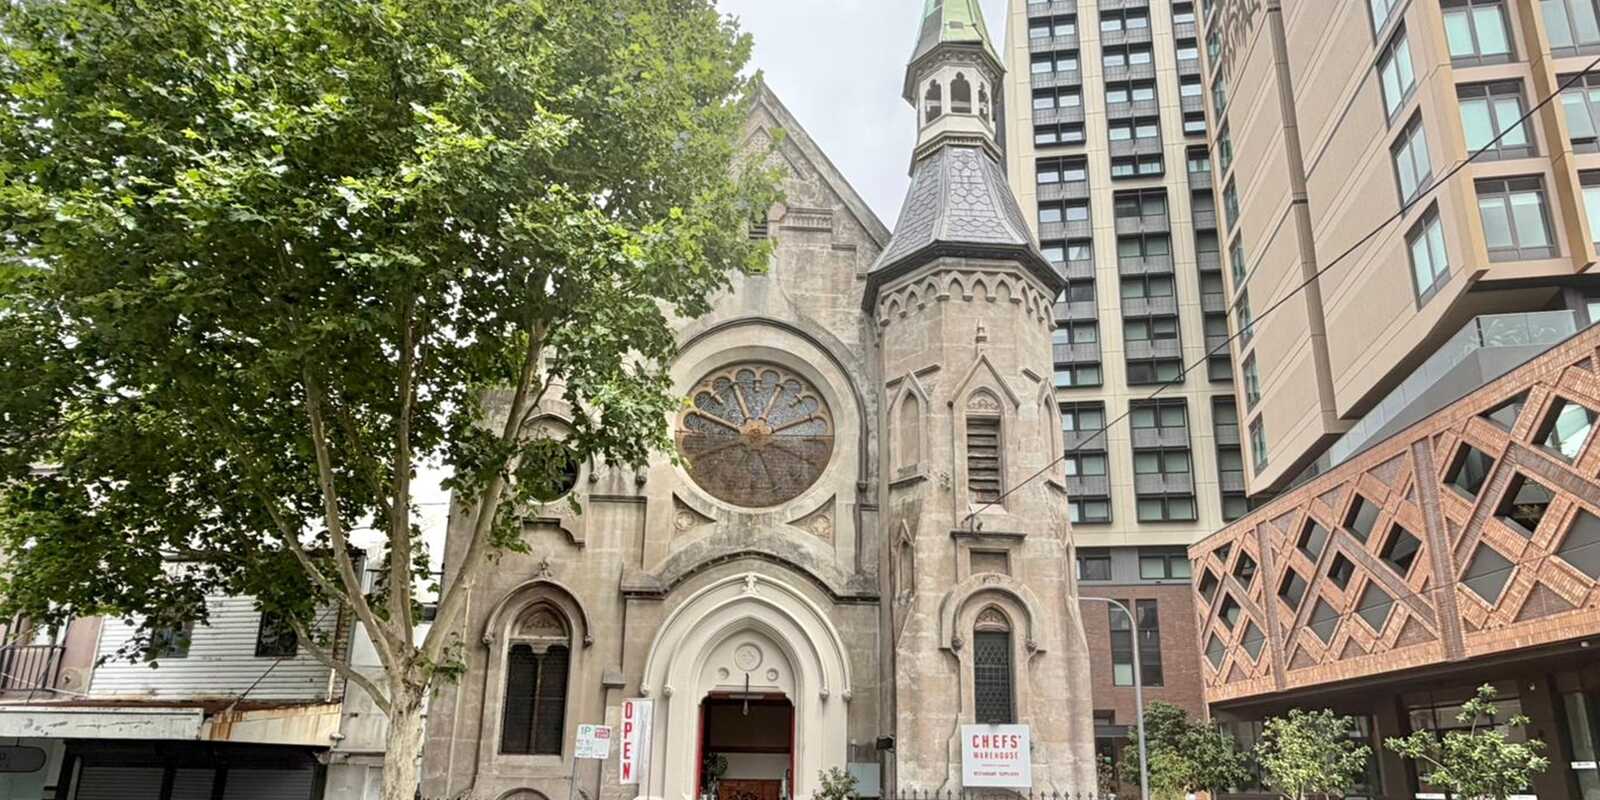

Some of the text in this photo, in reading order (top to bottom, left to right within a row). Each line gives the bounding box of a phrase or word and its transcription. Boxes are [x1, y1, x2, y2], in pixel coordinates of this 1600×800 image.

[622, 701, 634, 780] OPEN
[972, 734, 1022, 749] CHEFS'
[973, 751, 1019, 760] WAREHOUSE
